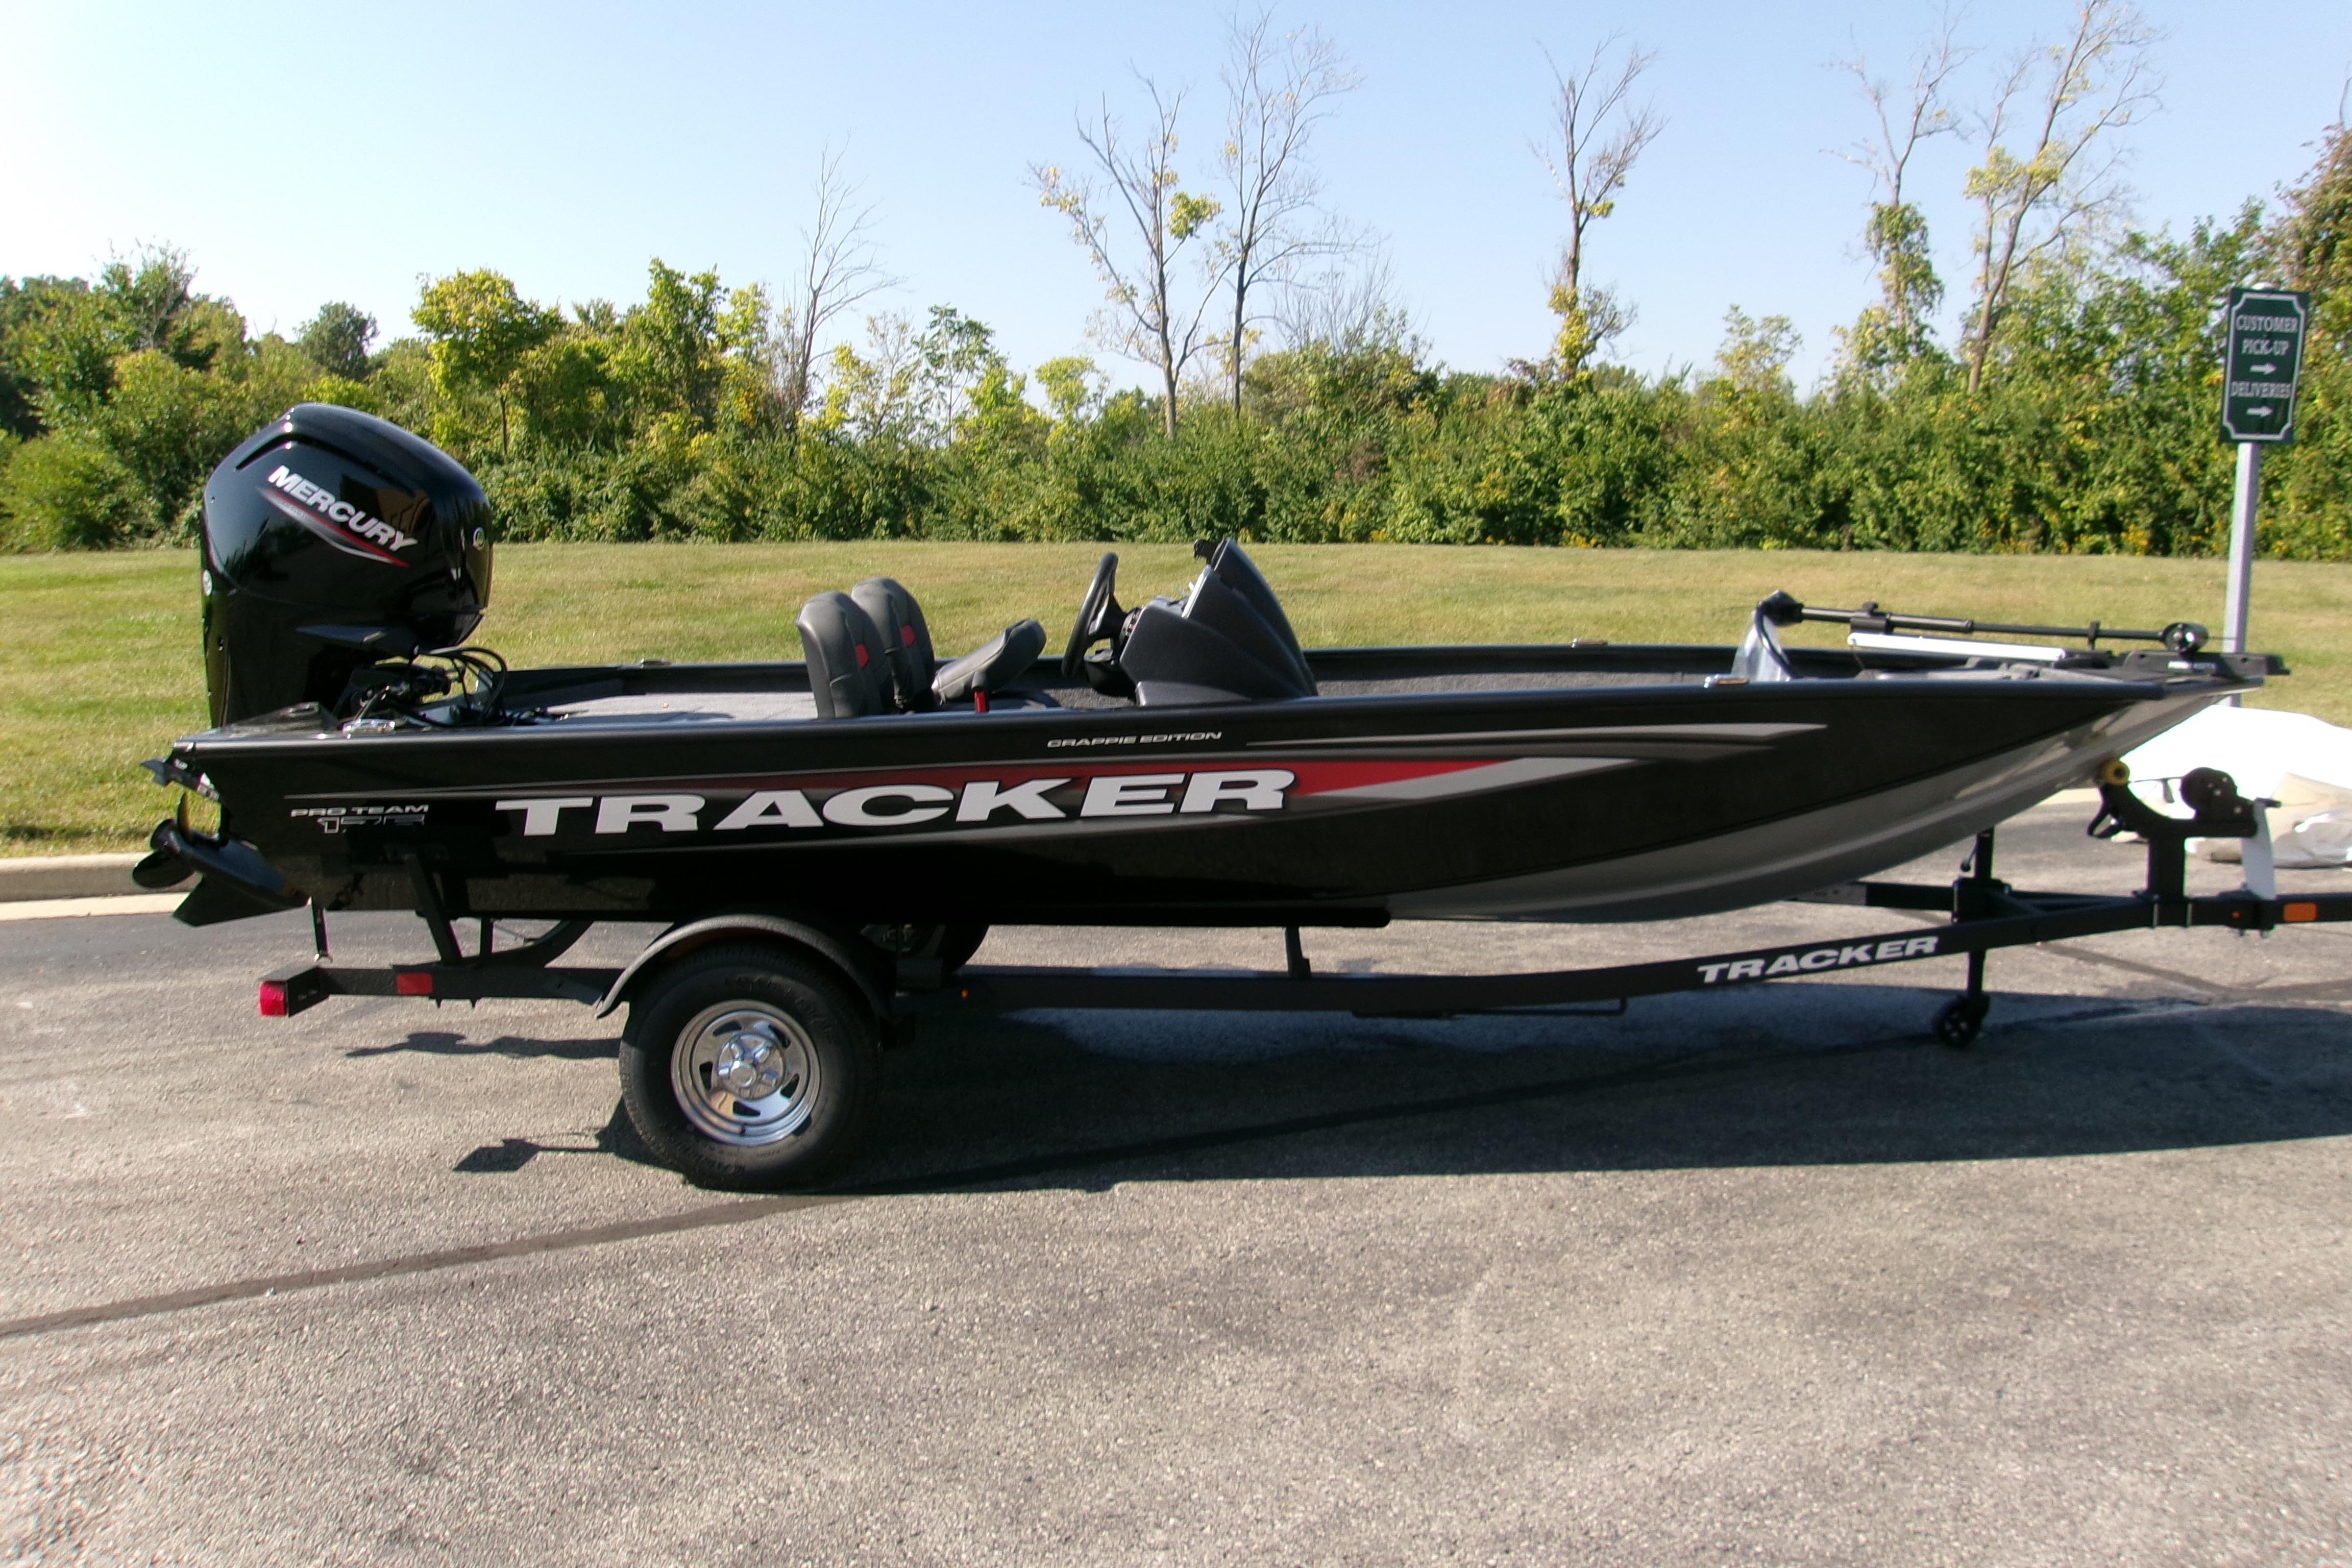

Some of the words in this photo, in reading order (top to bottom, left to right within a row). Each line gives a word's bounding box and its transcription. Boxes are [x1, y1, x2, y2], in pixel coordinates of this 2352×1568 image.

[2236, 314, 2299, 333] CUSTOMER
[2230, 381, 2292, 398] DELIVERIES
[267, 464, 419, 552] MERCURY
[1046, 735, 1137, 748] CRAPPIE
[1139, 731, 1223, 744] EDITION
[290, 807, 348, 818] PRO
[351, 804, 430, 815] TEAM
[494, 769, 1295, 836] TRACKER
[1697, 936, 1938, 984] TRACKER
